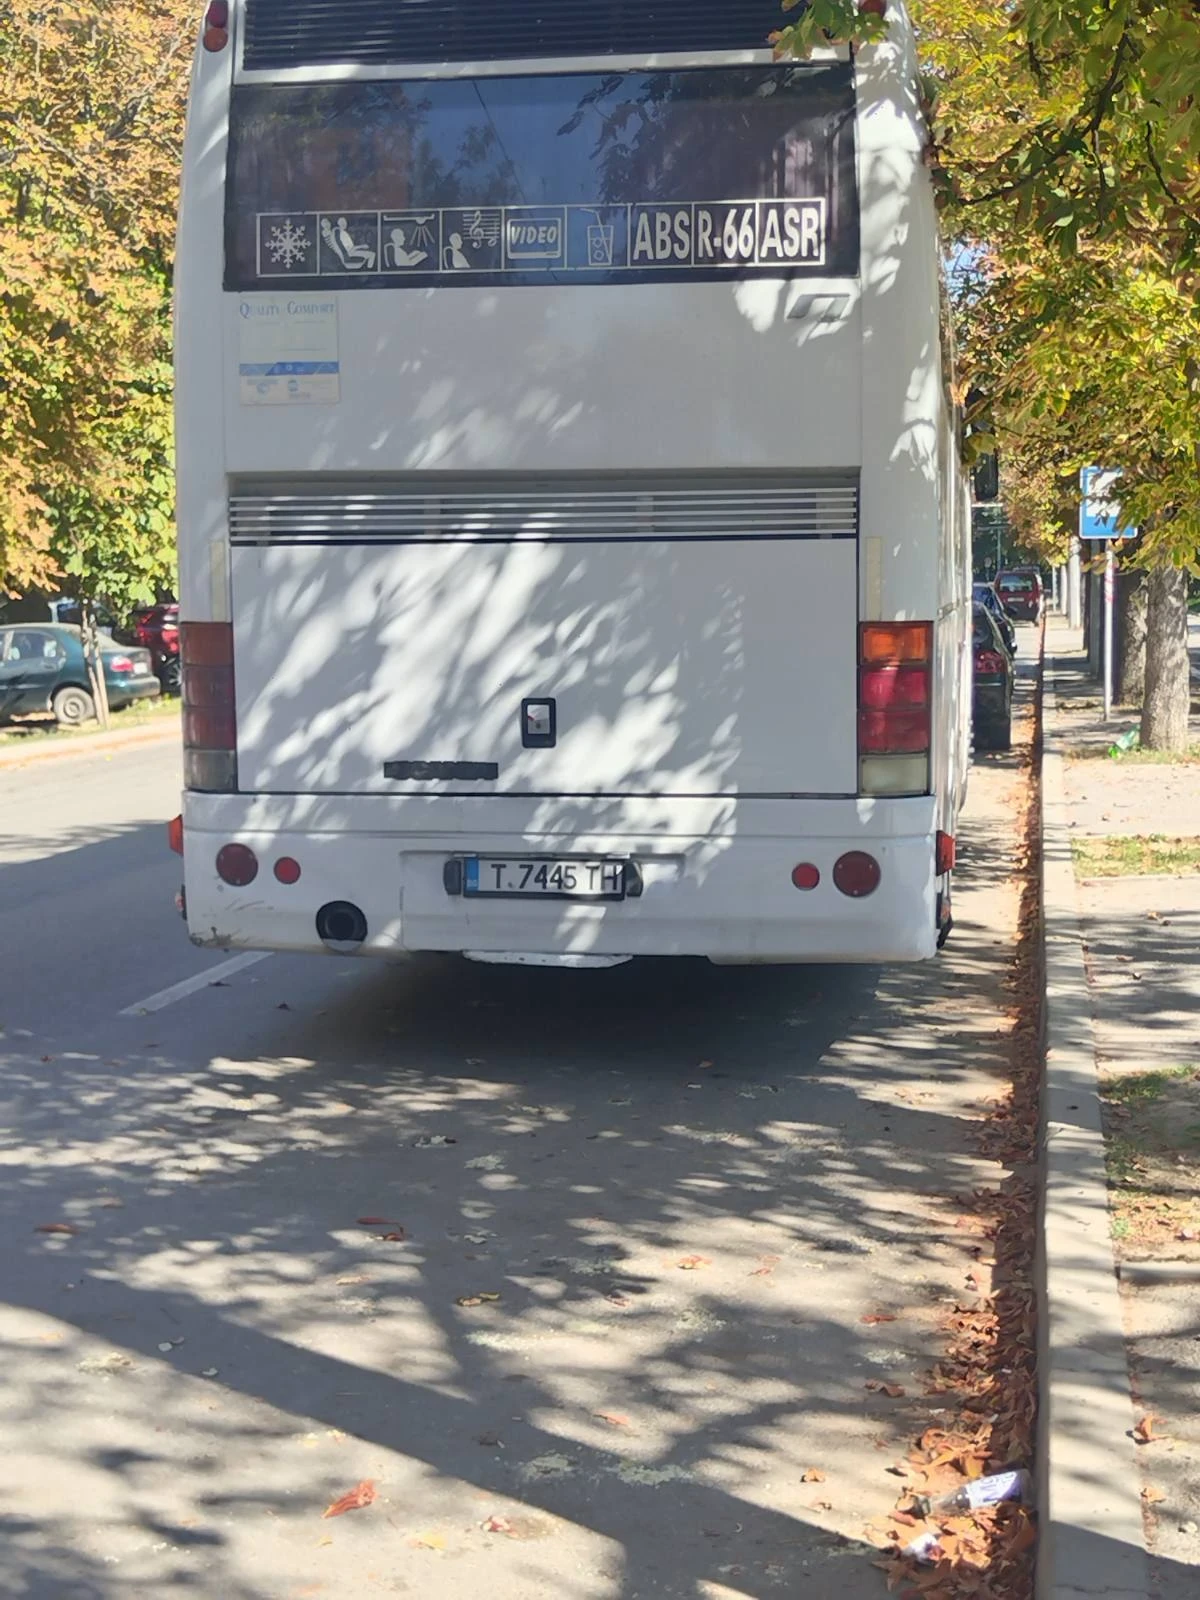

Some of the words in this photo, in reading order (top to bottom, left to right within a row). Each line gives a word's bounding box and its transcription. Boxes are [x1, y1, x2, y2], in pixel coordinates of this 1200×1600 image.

[511, 225, 557, 245] VIDEO
[633, 210, 691, 261] ABS
[759, 206, 820, 258] ASR
